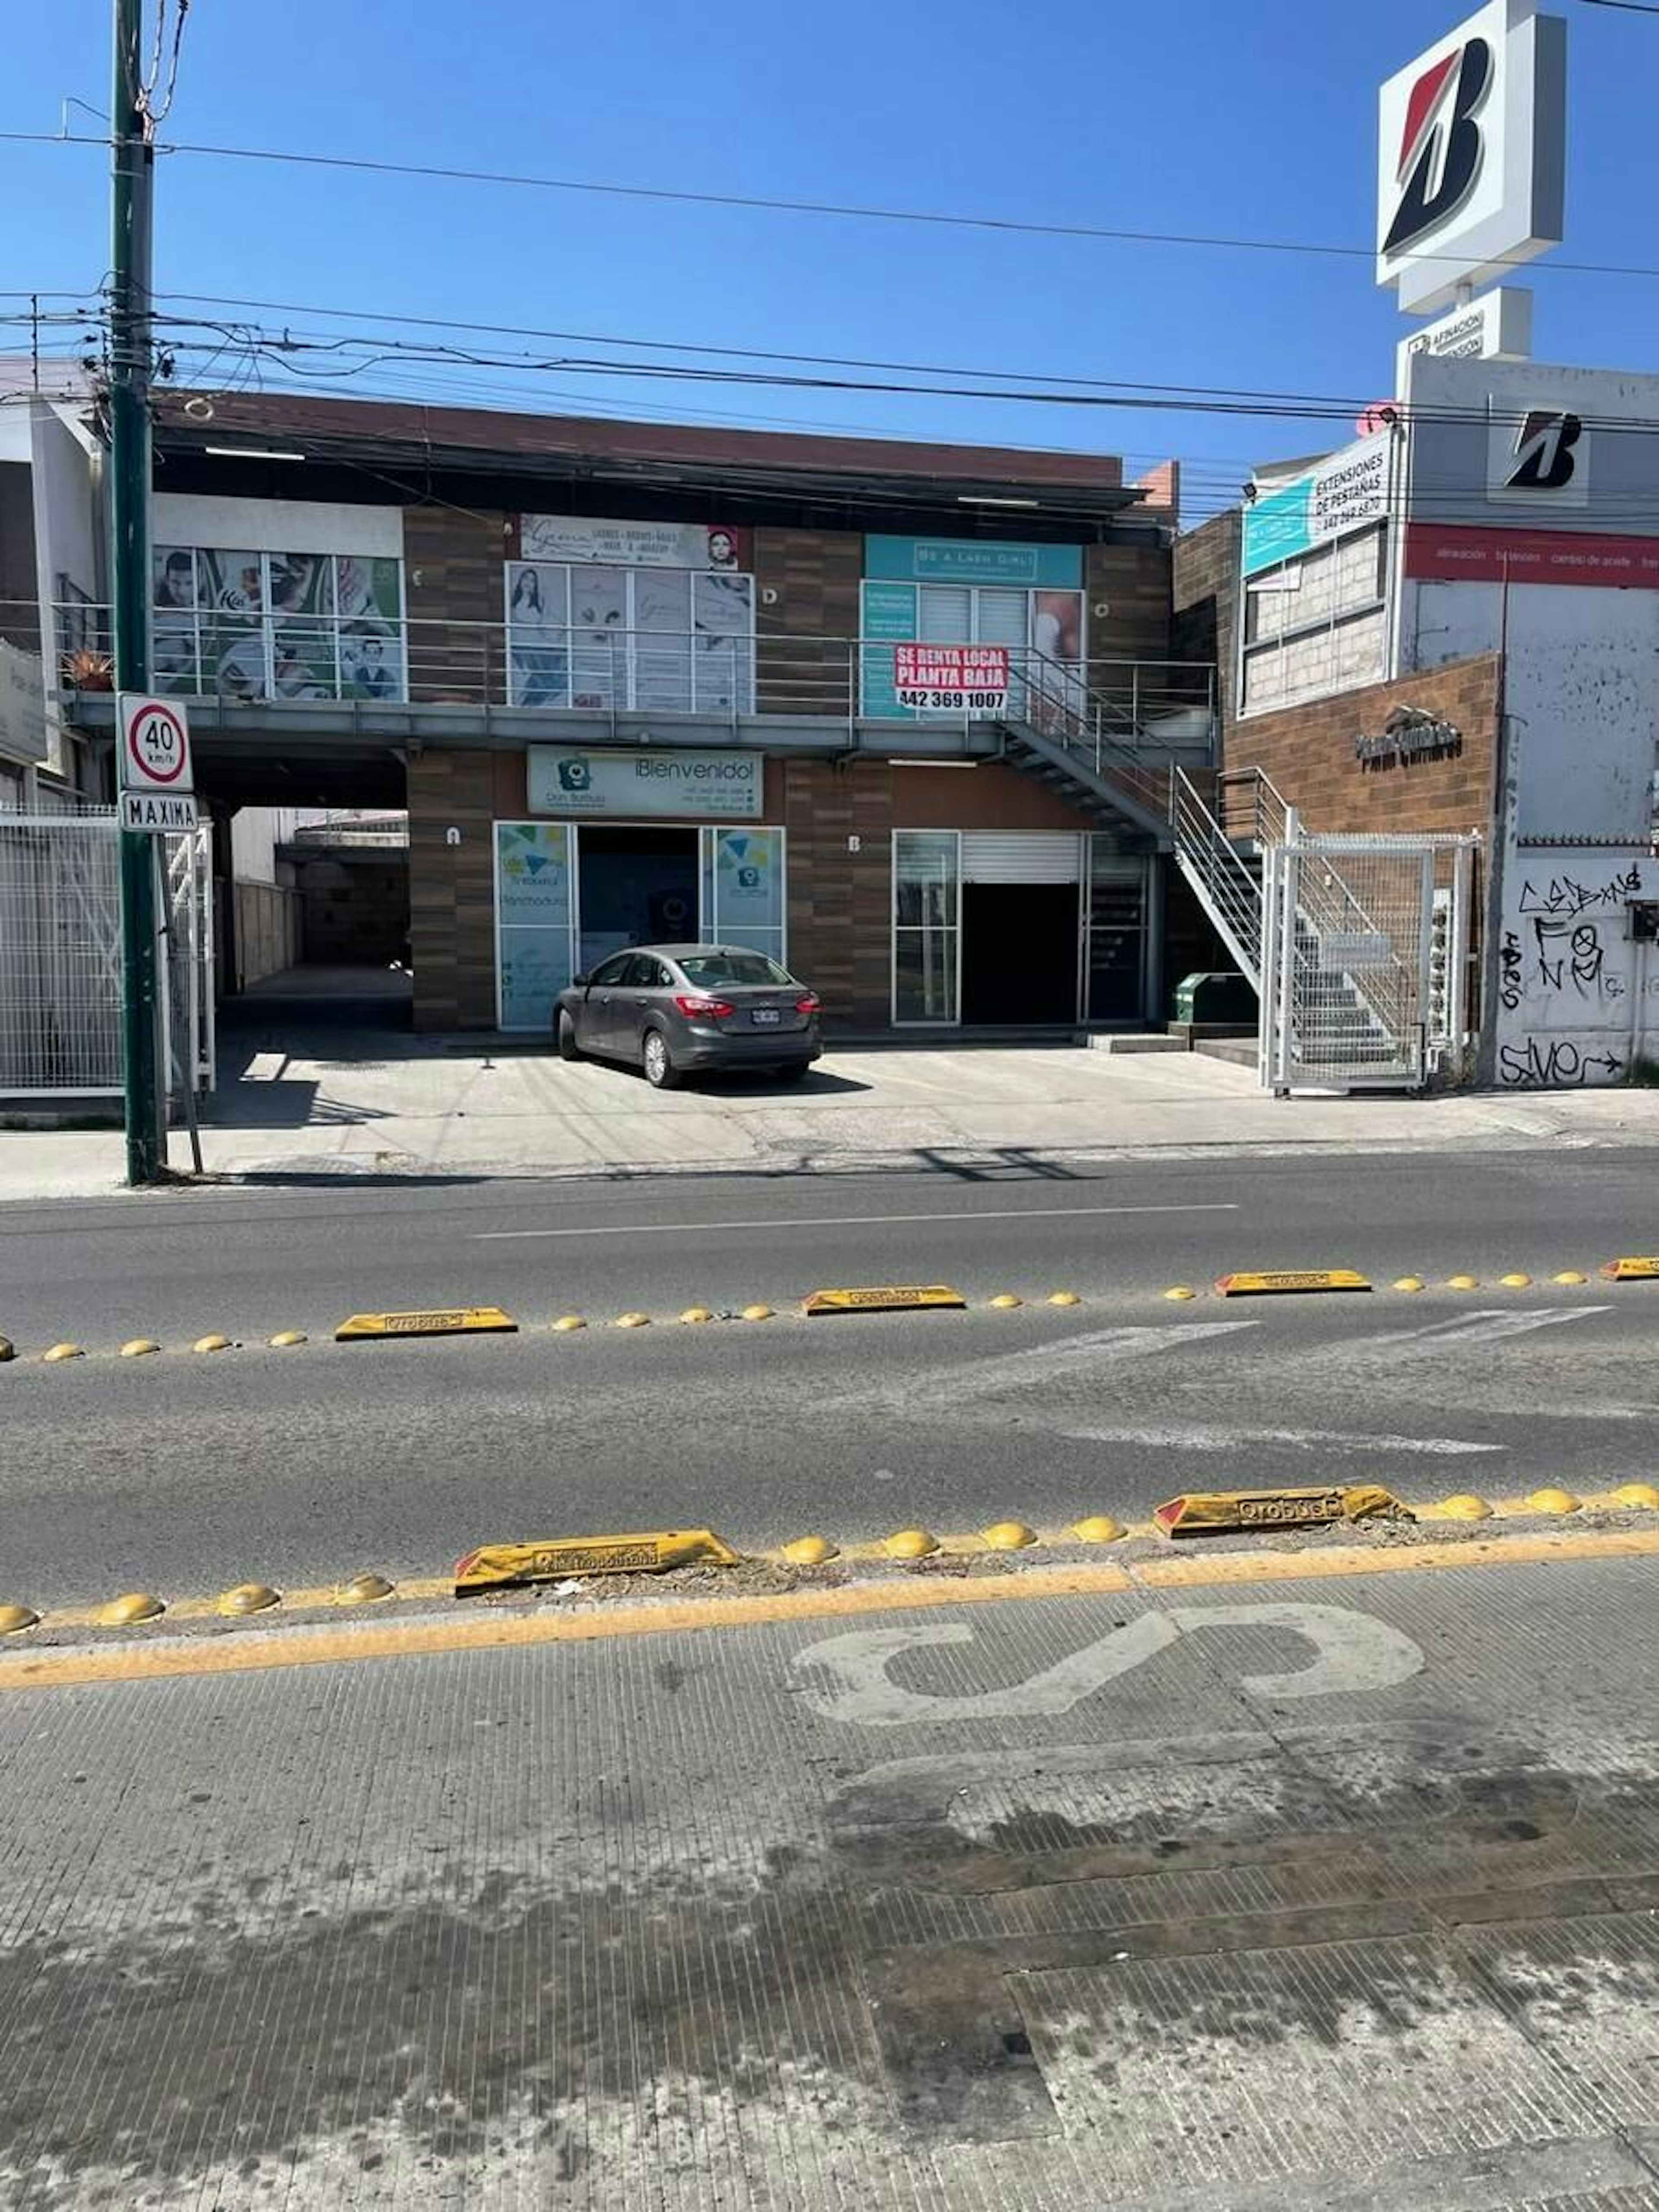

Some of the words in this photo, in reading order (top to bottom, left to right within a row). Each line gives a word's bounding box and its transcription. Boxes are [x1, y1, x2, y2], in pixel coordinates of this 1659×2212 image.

[1316, 452, 1382, 496] EXTENSIONES
[1316, 497, 1329, 515] DE
[763, 590, 777, 604] D
[897, 648, 916, 664] SE
[917, 648, 961, 666] RENTA
[963, 649, 1004, 667] LOCAL
[898, 667, 960, 686] PLANTA
[963, 668, 1004, 687] BAJA
[899, 691, 928, 706] 442
[931, 692, 963, 708] 369
[968, 693, 1003, 708] 1007
[146, 721, 172, 750] 40
[130, 800, 194, 826] MAXIMA
[446, 826, 461, 844] A
[848, 836, 861, 851] B
